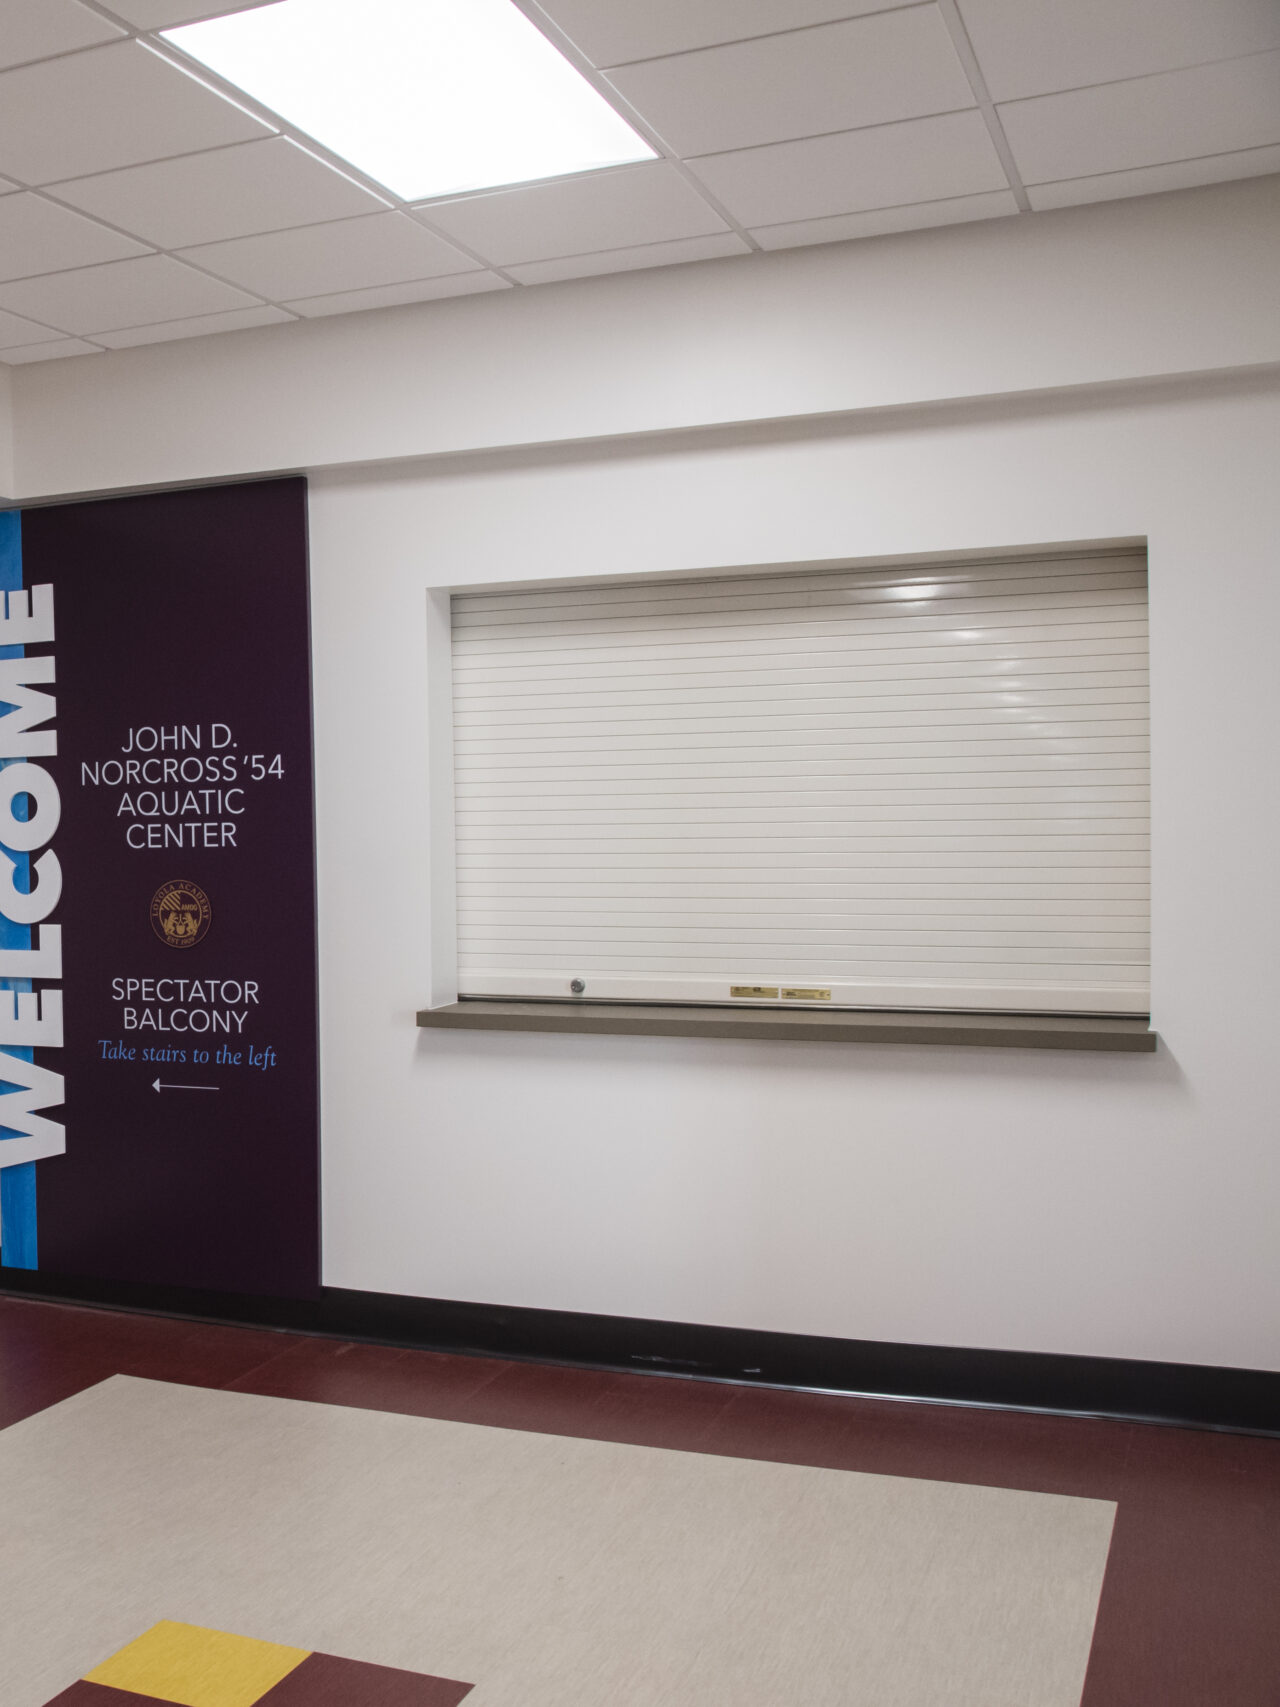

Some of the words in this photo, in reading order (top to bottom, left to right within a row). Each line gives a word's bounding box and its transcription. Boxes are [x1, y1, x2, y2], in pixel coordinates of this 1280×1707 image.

[121, 724, 201, 752] JOHN
[211, 723, 238, 749] D.
[81, 756, 238, 786] NORCROSS
[117, 788, 245, 817] AQUATIC
[126, 822, 237, 849] CENTER
[152, 884, 175, 918] LOYOLA
[178, 882, 210, 920] ACADEMY
[111, 977, 260, 1005] SPECTATOR
[123, 1007, 249, 1034] BALCONY
[98, 1040, 137, 1061] Take
[142, 1044, 187, 1064] stairs
[193, 1047, 210, 1065] to
[216, 1045, 243, 1067] the
[248, 1046, 278, 1071] left
